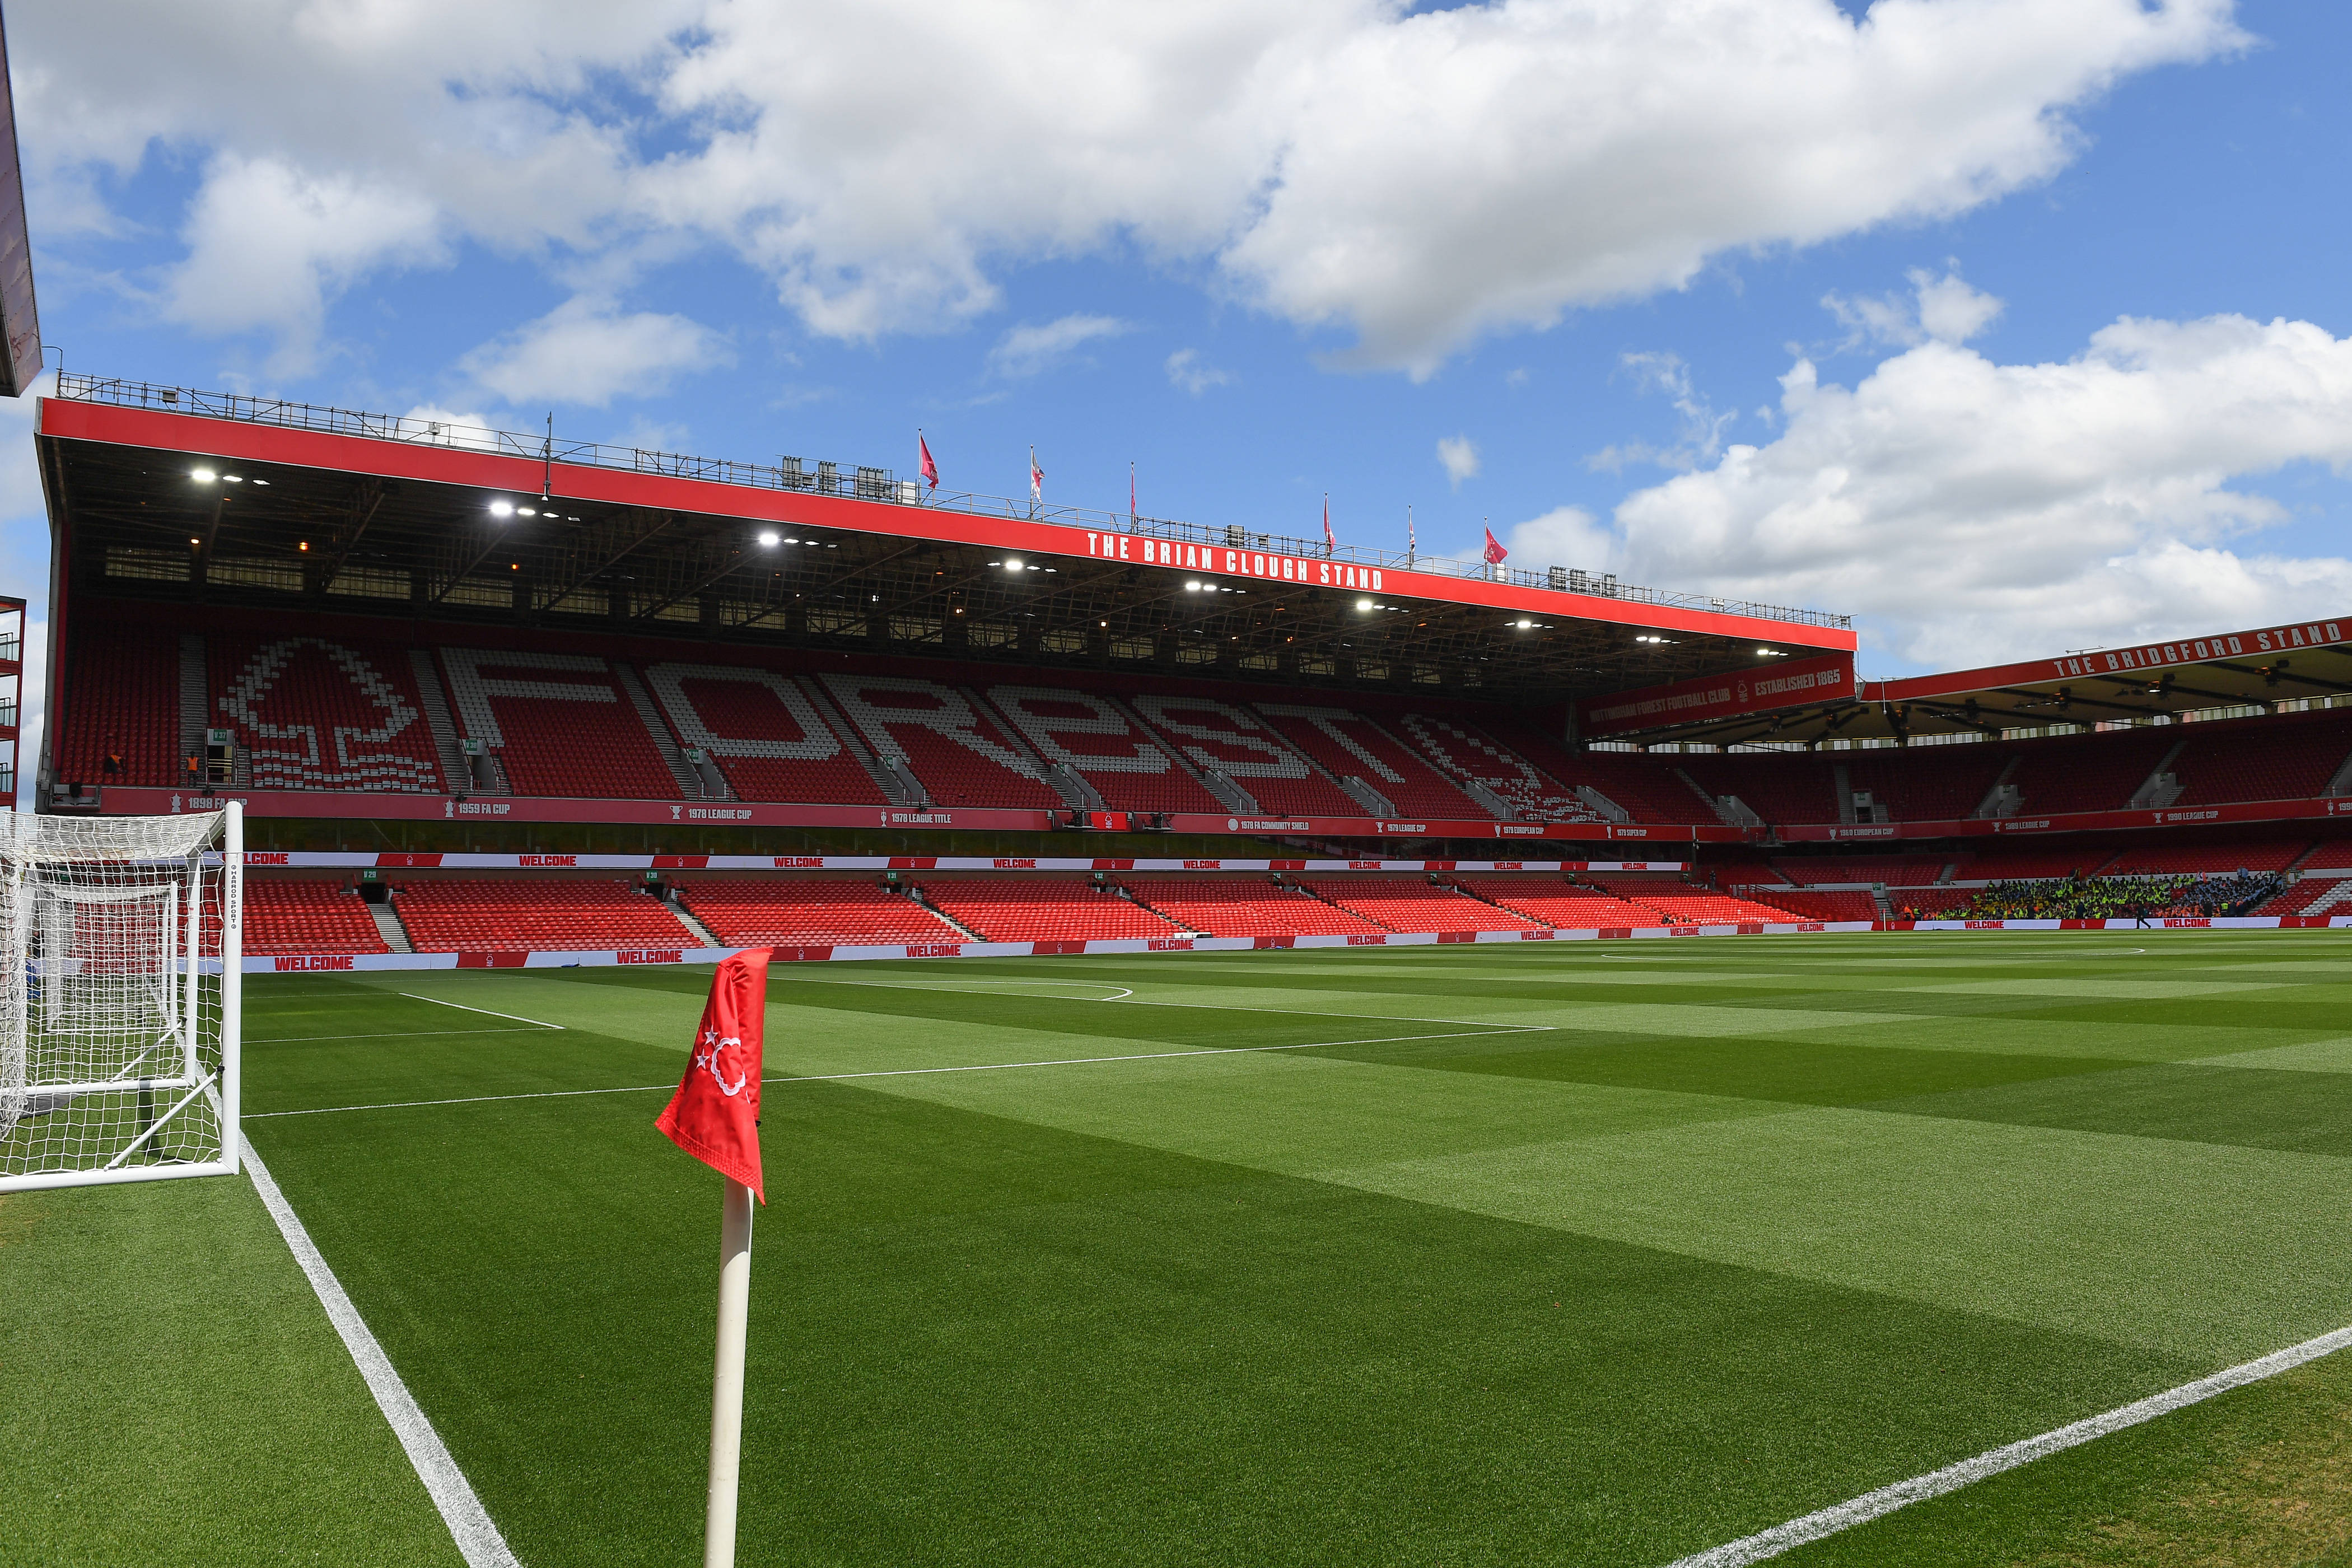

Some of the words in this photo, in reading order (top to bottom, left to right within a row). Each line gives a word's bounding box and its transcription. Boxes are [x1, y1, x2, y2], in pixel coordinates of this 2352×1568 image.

[1087, 532, 1130, 559] THE
[1144, 539, 1212, 570] BRIAN
[1226, 550, 1308, 582] CLOUGH
[1320, 563, 1382, 591] STAND
[2054, 659, 2094, 677] THE
[2105, 635, 2242, 670] BRIDGFORD
[2256, 622, 2341, 650] STAND
[1754, 674, 1815, 697] ESTABLISHED
[1816, 668, 1841, 686] 1865
[1637, 698, 1667, 715] FOREST
[1667, 692, 1707, 710] FOOTBALL
[1709, 688, 1731, 704] CLUB
[188, 797, 213, 809] 1898
[214, 797, 226, 809] FA
[458, 803, 480, 814] 1959
[481, 803, 491, 814] FA
[493, 804, 510, 814] CUP
[688, 808, 707, 819] 1978
[708, 809, 736, 819] LEAGUE
[737, 809, 752, 819] CUP
[892, 813, 908, 823] 1978
[908, 813, 934, 823] LEAGUE
[934, 814, 951, 823] TITLE
[2167, 813, 2182, 821] 1990
[2182, 811, 2205, 820] LEAGUE
[2206, 810, 2218, 819] CUP
[1241, 820, 1254, 829] 1978
[1254, 821, 1261, 829] FA
[1261, 821, 1291, 830] COMMUNITY
[1291, 822, 1309, 830] SHIELD
[1399, 824, 1416, 832] LEAGUE
[222, 853, 288, 864] LCOME
[520, 856, 576, 866] WELCOME
[774, 857, 823, 867] WELCOME
[994, 859, 1035, 868] WELCOME
[2164, 918, 2209, 927] WELCOME
[1522, 931, 1553, 940] WELCOME
[1670, 927, 1698, 936] WELCOME
[1148, 940, 1193, 950] WELCOME
[1347, 935, 1385, 945] WELCOME
[907, 945, 960, 957] WELCOME
[618, 950, 682, 964] WELCOME
[276, 956, 353, 970] WELCOME
